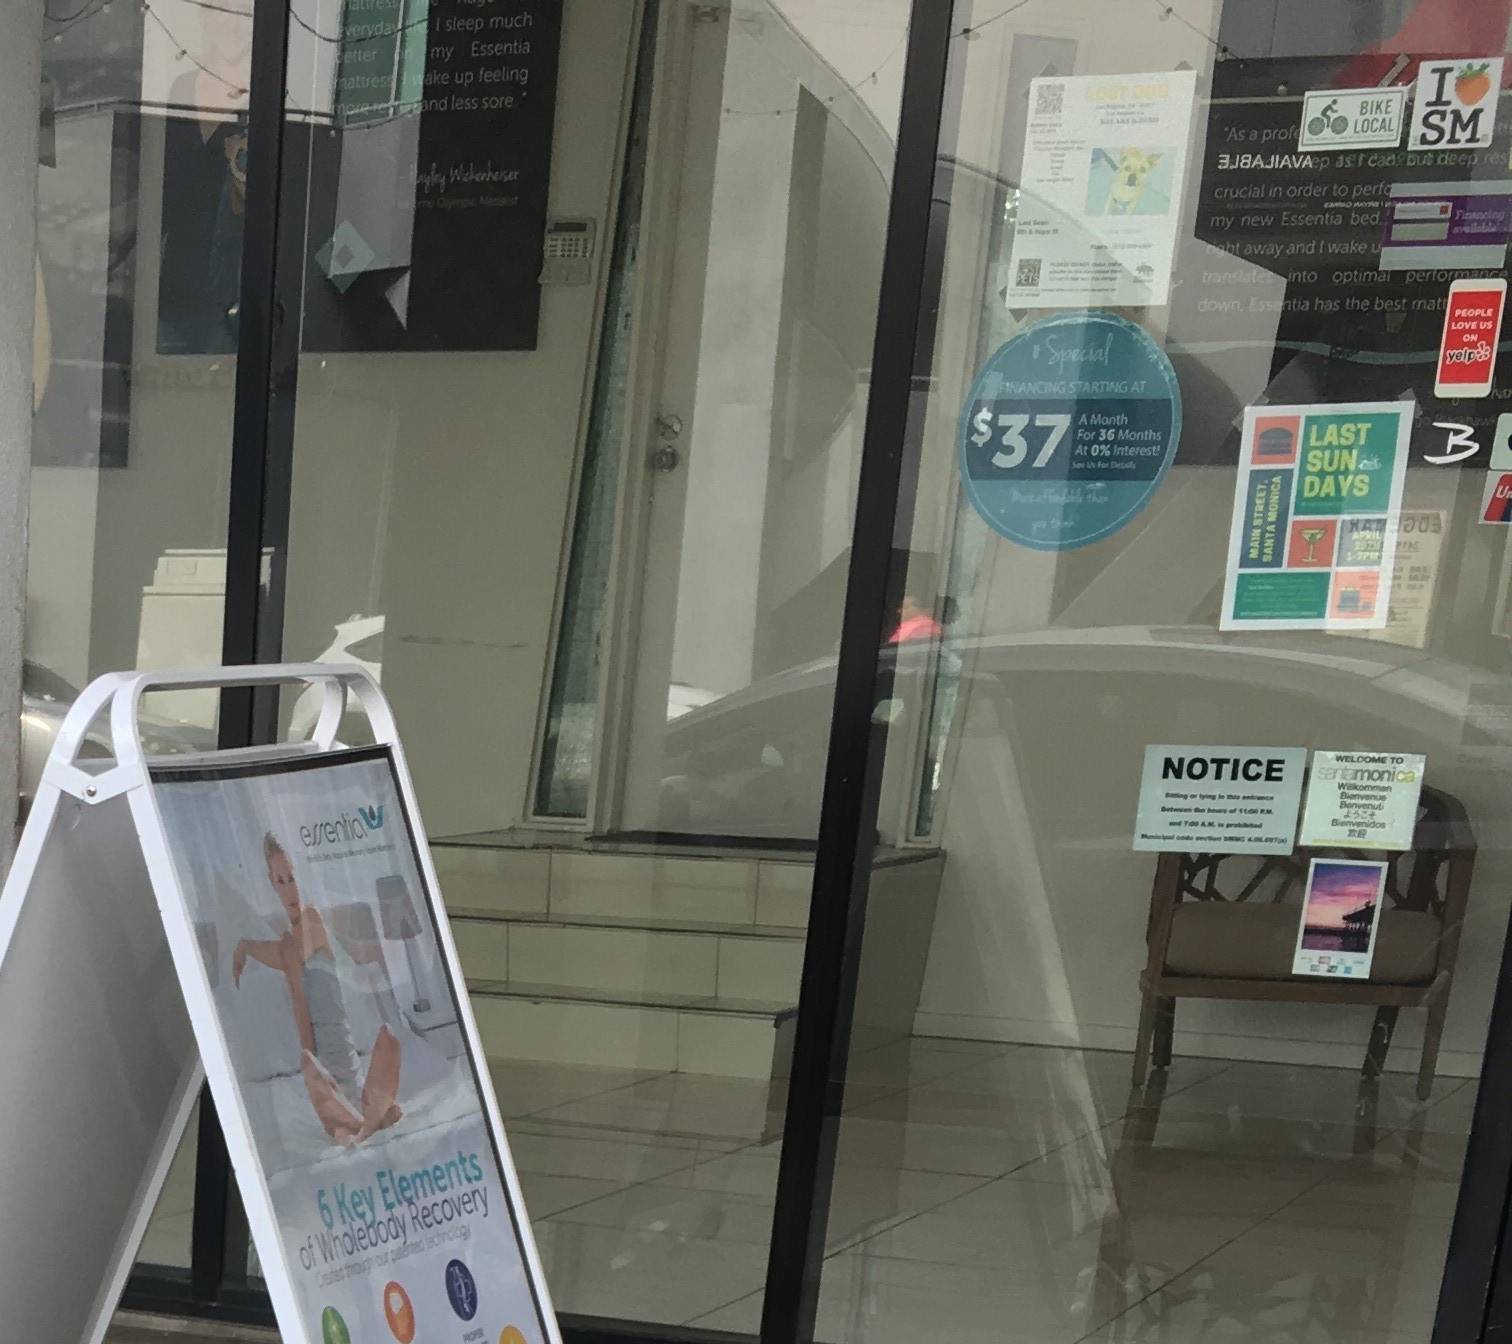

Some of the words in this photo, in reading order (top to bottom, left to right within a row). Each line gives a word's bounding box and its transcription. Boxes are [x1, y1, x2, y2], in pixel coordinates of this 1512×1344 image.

[445, 16, 485, 33] sleep
[490, 11, 533, 28] much
[430, 46, 454, 63] my
[471, 40, 531, 57] Essentia
[454, 69, 474, 87] up
[478, 67, 529, 86] feeling
[1424, 66, 1454, 107] I
[421, 95, 448, 112] and
[451, 96, 478, 110] less
[1359, 99, 1392, 116] BIKE
[1261, 125, 1300, 143] profe
[1353, 117, 1395, 134] LOCAL
[1419, 108, 1484, 147] SM
[1214, 183, 1265, 199] crucial
[1269, 184, 1282, 198] in
[1287, 183, 1328, 198] order
[1332, 183, 1348, 197] to
[1352, 181, 1392, 200] perfo
[1210, 214, 1235, 230] my
[1241, 214, 1274, 227] new
[1281, 211, 1343, 226] Essentia
[1244, 243, 1283, 258] away
[1287, 240, 1315, 255] and
[1327, 239, 1368, 255] wake
[1288, 269, 1318, 283] into
[1249, 298, 1310, 312] Essentia
[1314, 297, 1340, 311] has
[1345, 297, 1370, 311] the
[1374, 297, 1410, 311] best
[1412, 297, 1447, 310] matt
[1455, 308, 1494, 318] PEOPLE
[1451, 321, 1478, 330] LOVE
[1479, 321, 1493, 330] US
[1462, 334, 1478, 342] ON
[1446, 346, 1477, 365] yelp
[999, 381, 1066, 394] FINANCING
[1069, 380, 1127, 393] STARTING
[1129, 380, 1147, 392] AT
[1078, 413, 1088, 425] A
[1090, 413, 1128, 425] Month
[971, 407, 1072, 469] $37
[1077, 429, 1095, 441] For
[1098, 429, 1116, 441] 36
[1117, 429, 1162, 441] Months
[1309, 422, 1372, 447] LAST
[1074, 445, 1088, 456] At
[1091, 444, 1111, 457] 0%
[1113, 444, 1160, 457] Interest!
[1306, 449, 1359, 473] SUN
[1303, 474, 1370, 499] DAYS
[1267, 475, 1282, 523] MONICA
[1249, 525, 1260, 559] MAIN
[1262, 525, 1276, 562] SANTA
[1351, 530, 1380, 540] APRIL
[1335, 755, 1388, 764] WELCOME
[1390, 756, 1404, 764] TO
[1162, 756, 1286, 782] NOTICE
[1337, 782, 1393, 792] Willkommen
[1339, 791, 1387, 801] Bienvenue
[1199, 793, 1216, 801] lying
[1339, 800, 1385, 810] Benvenuti
[299, 812, 369, 847] essentia
[1331, 819, 1386, 829] Bienvenidos
[1141, 833, 1175, 841] Municipal
[316, 1188, 335, 1231] 6
[332, 1182, 377, 1228] Key
[376, 1150, 484, 1211] Elements
[299, 1235, 317, 1271] of
[314, 1209, 408, 1264] Wholebody
[407, 1186, 489, 1233] Recovery
